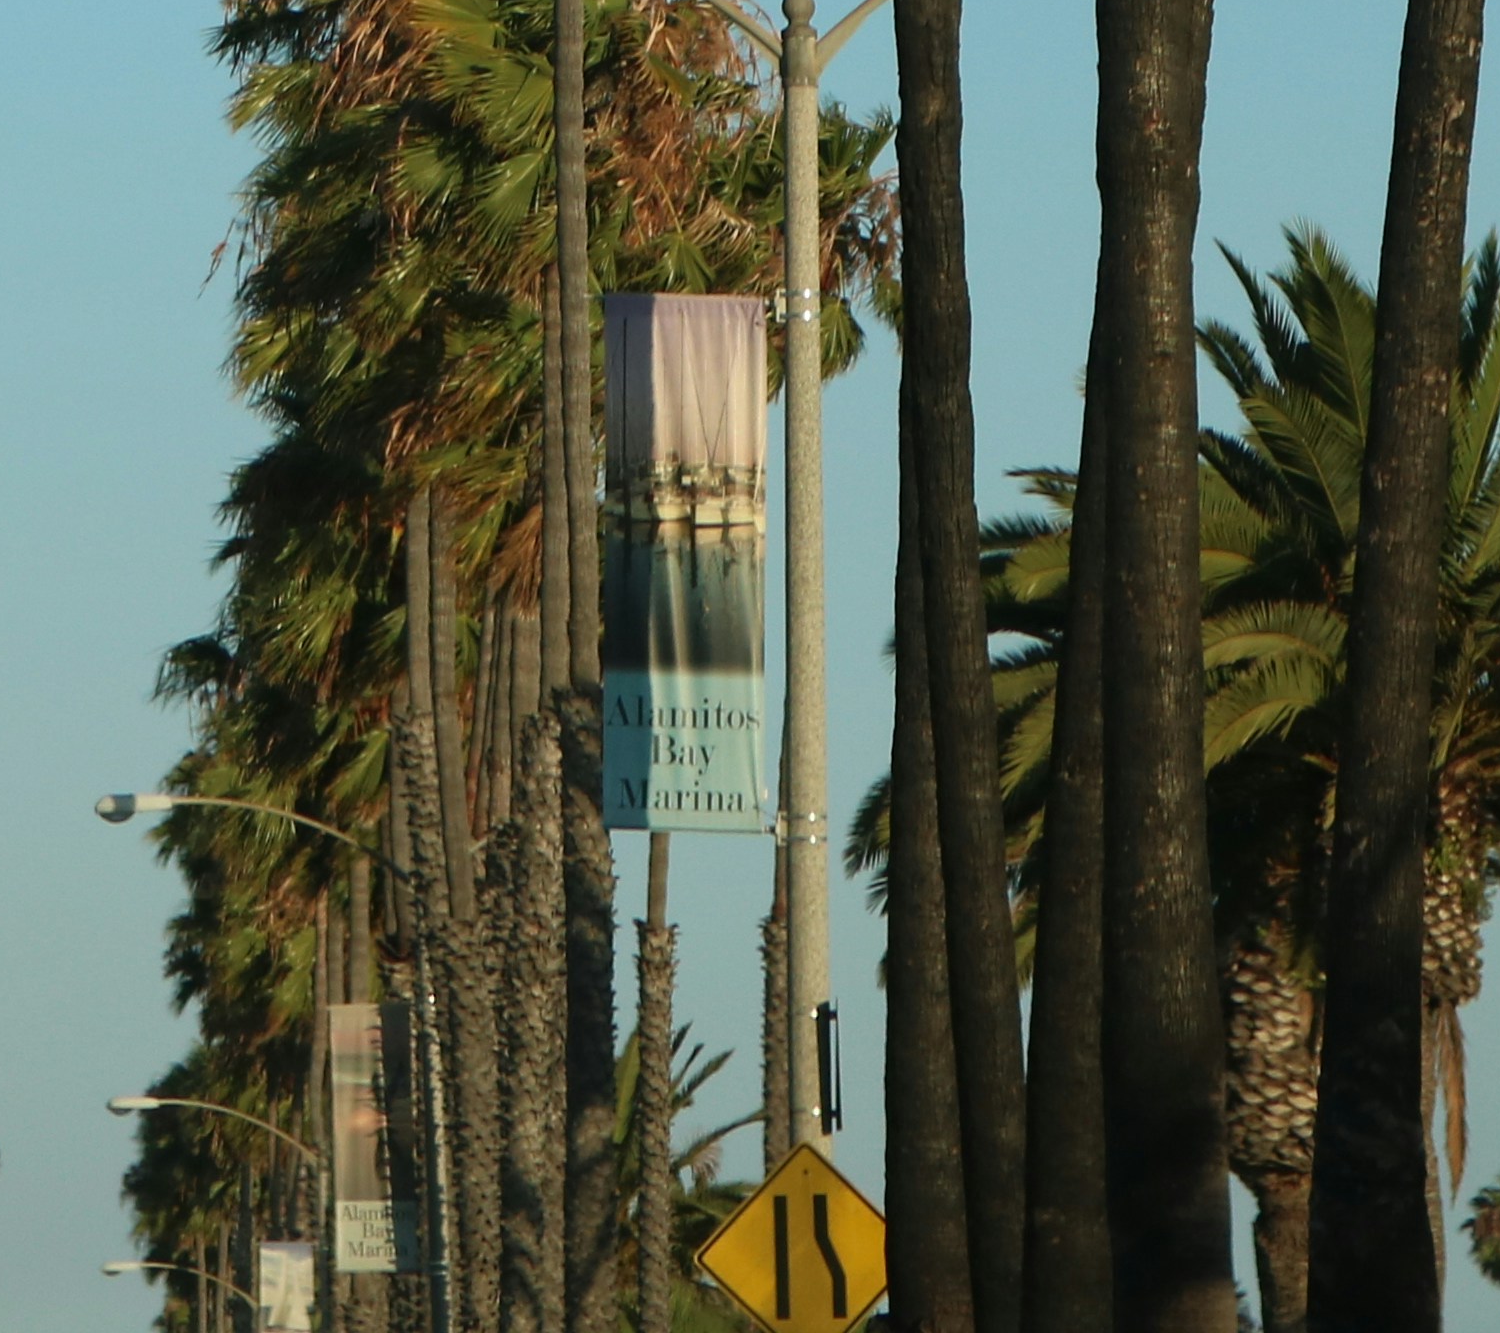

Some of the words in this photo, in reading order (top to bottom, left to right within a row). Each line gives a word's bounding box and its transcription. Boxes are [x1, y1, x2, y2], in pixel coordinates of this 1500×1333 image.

[607, 694, 760, 730] Alamitos
[652, 734, 716, 776] Bay
[619, 777, 743, 813] Marina
[342, 1204, 415, 1222] Alam
